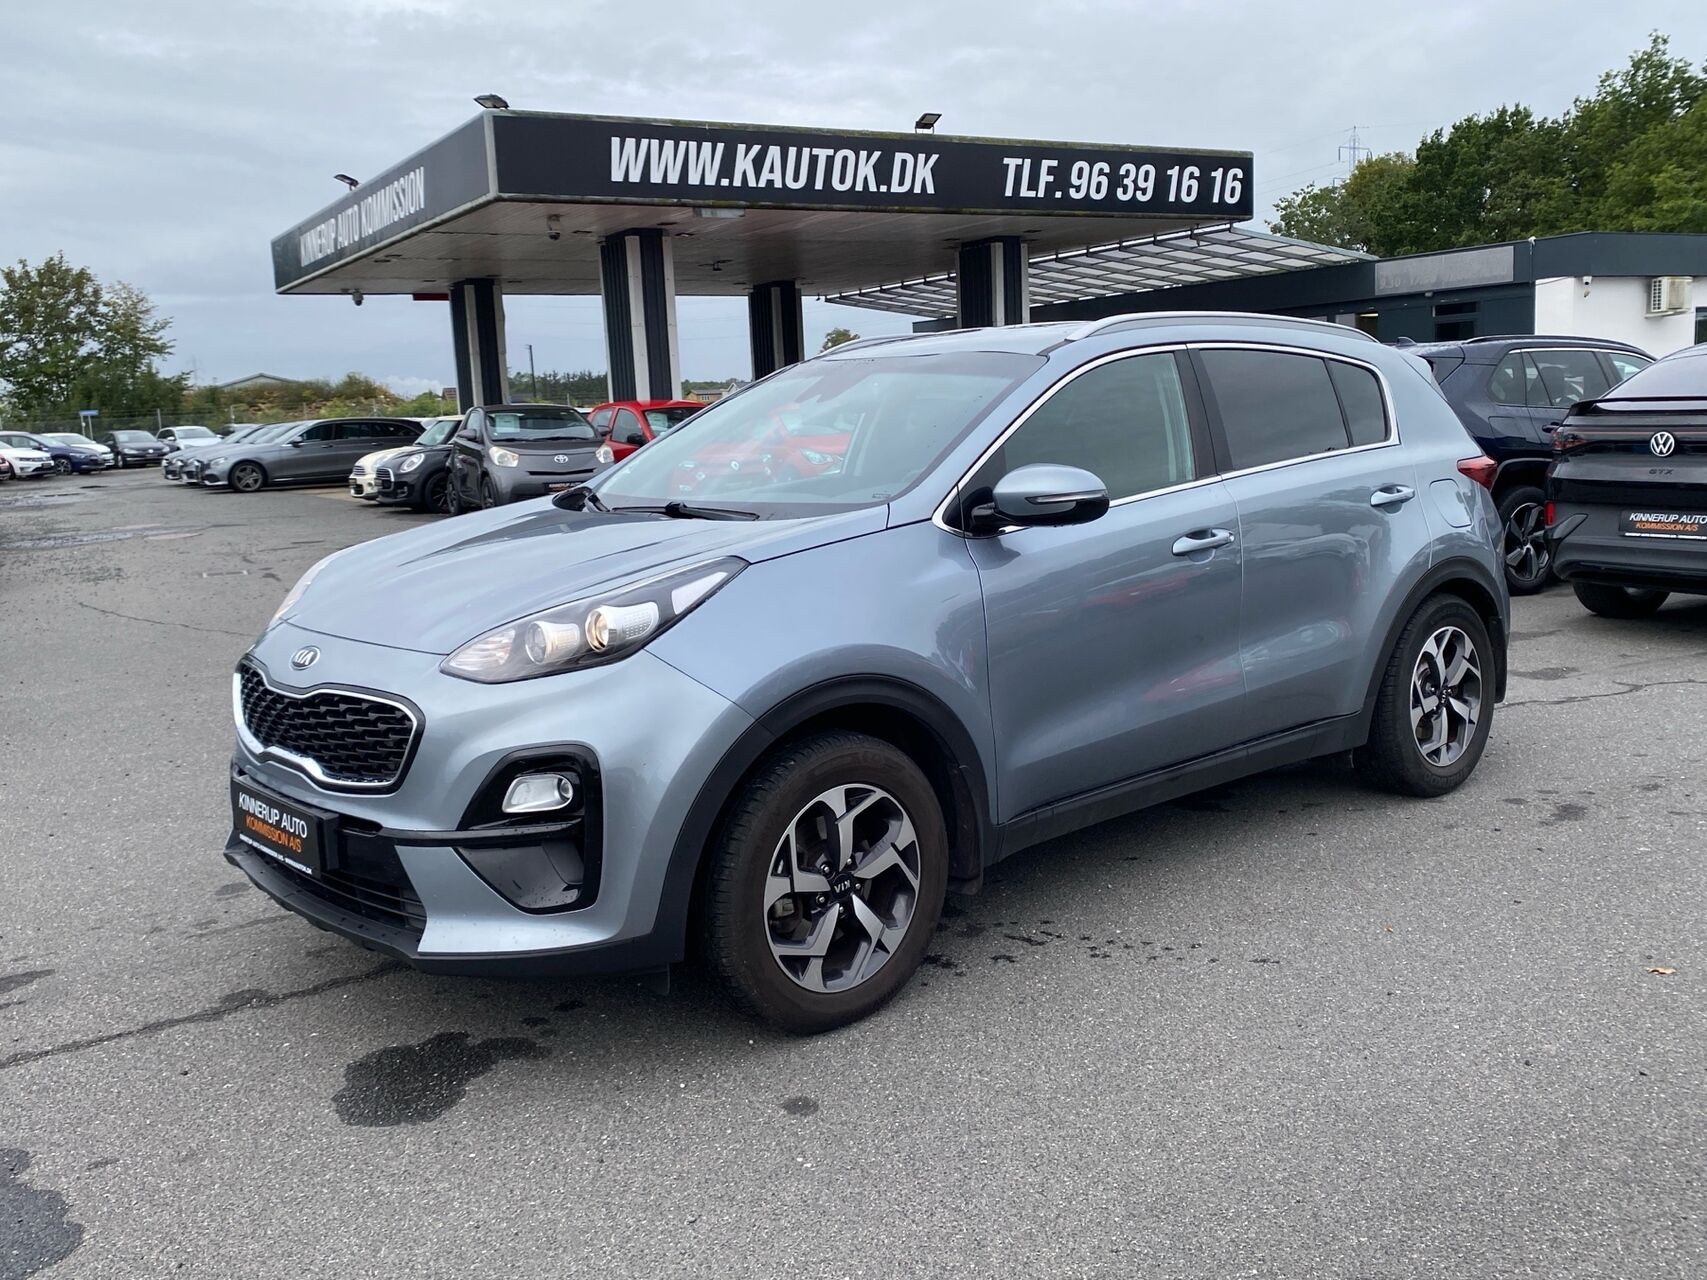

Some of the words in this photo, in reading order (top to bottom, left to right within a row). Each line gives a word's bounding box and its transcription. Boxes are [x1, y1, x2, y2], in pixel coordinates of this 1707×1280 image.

[610, 136, 940, 195] WWW.KAUTOK.DK
[1003, 157, 1063, 199] TLF.
[1069, 160, 1111, 201] 96
[1116, 163, 1156, 202] 39
[1167, 165, 1201, 203] 16
[1211, 167, 1244, 205] 16
[300, 218, 336, 267] KINNERUP
[337, 204, 360, 249] AUTO
[360, 166, 425, 238] KOMMISSION
[1629, 512, 1679, 523] KINNERUP
[1679, 514, 1707, 524] AUTO
[1636, 522, 1684, 531] KOMMISSION
[1684, 524, 1699, 532] A/S
[293, 648, 317, 667] KIA
[239, 792, 280, 825] KINNERUP
[281, 813, 308, 839] AUTO
[245, 814, 289, 847] KOMMISSION
[289, 836, 302, 853] A/S
[833, 879, 851, 894] KIA
